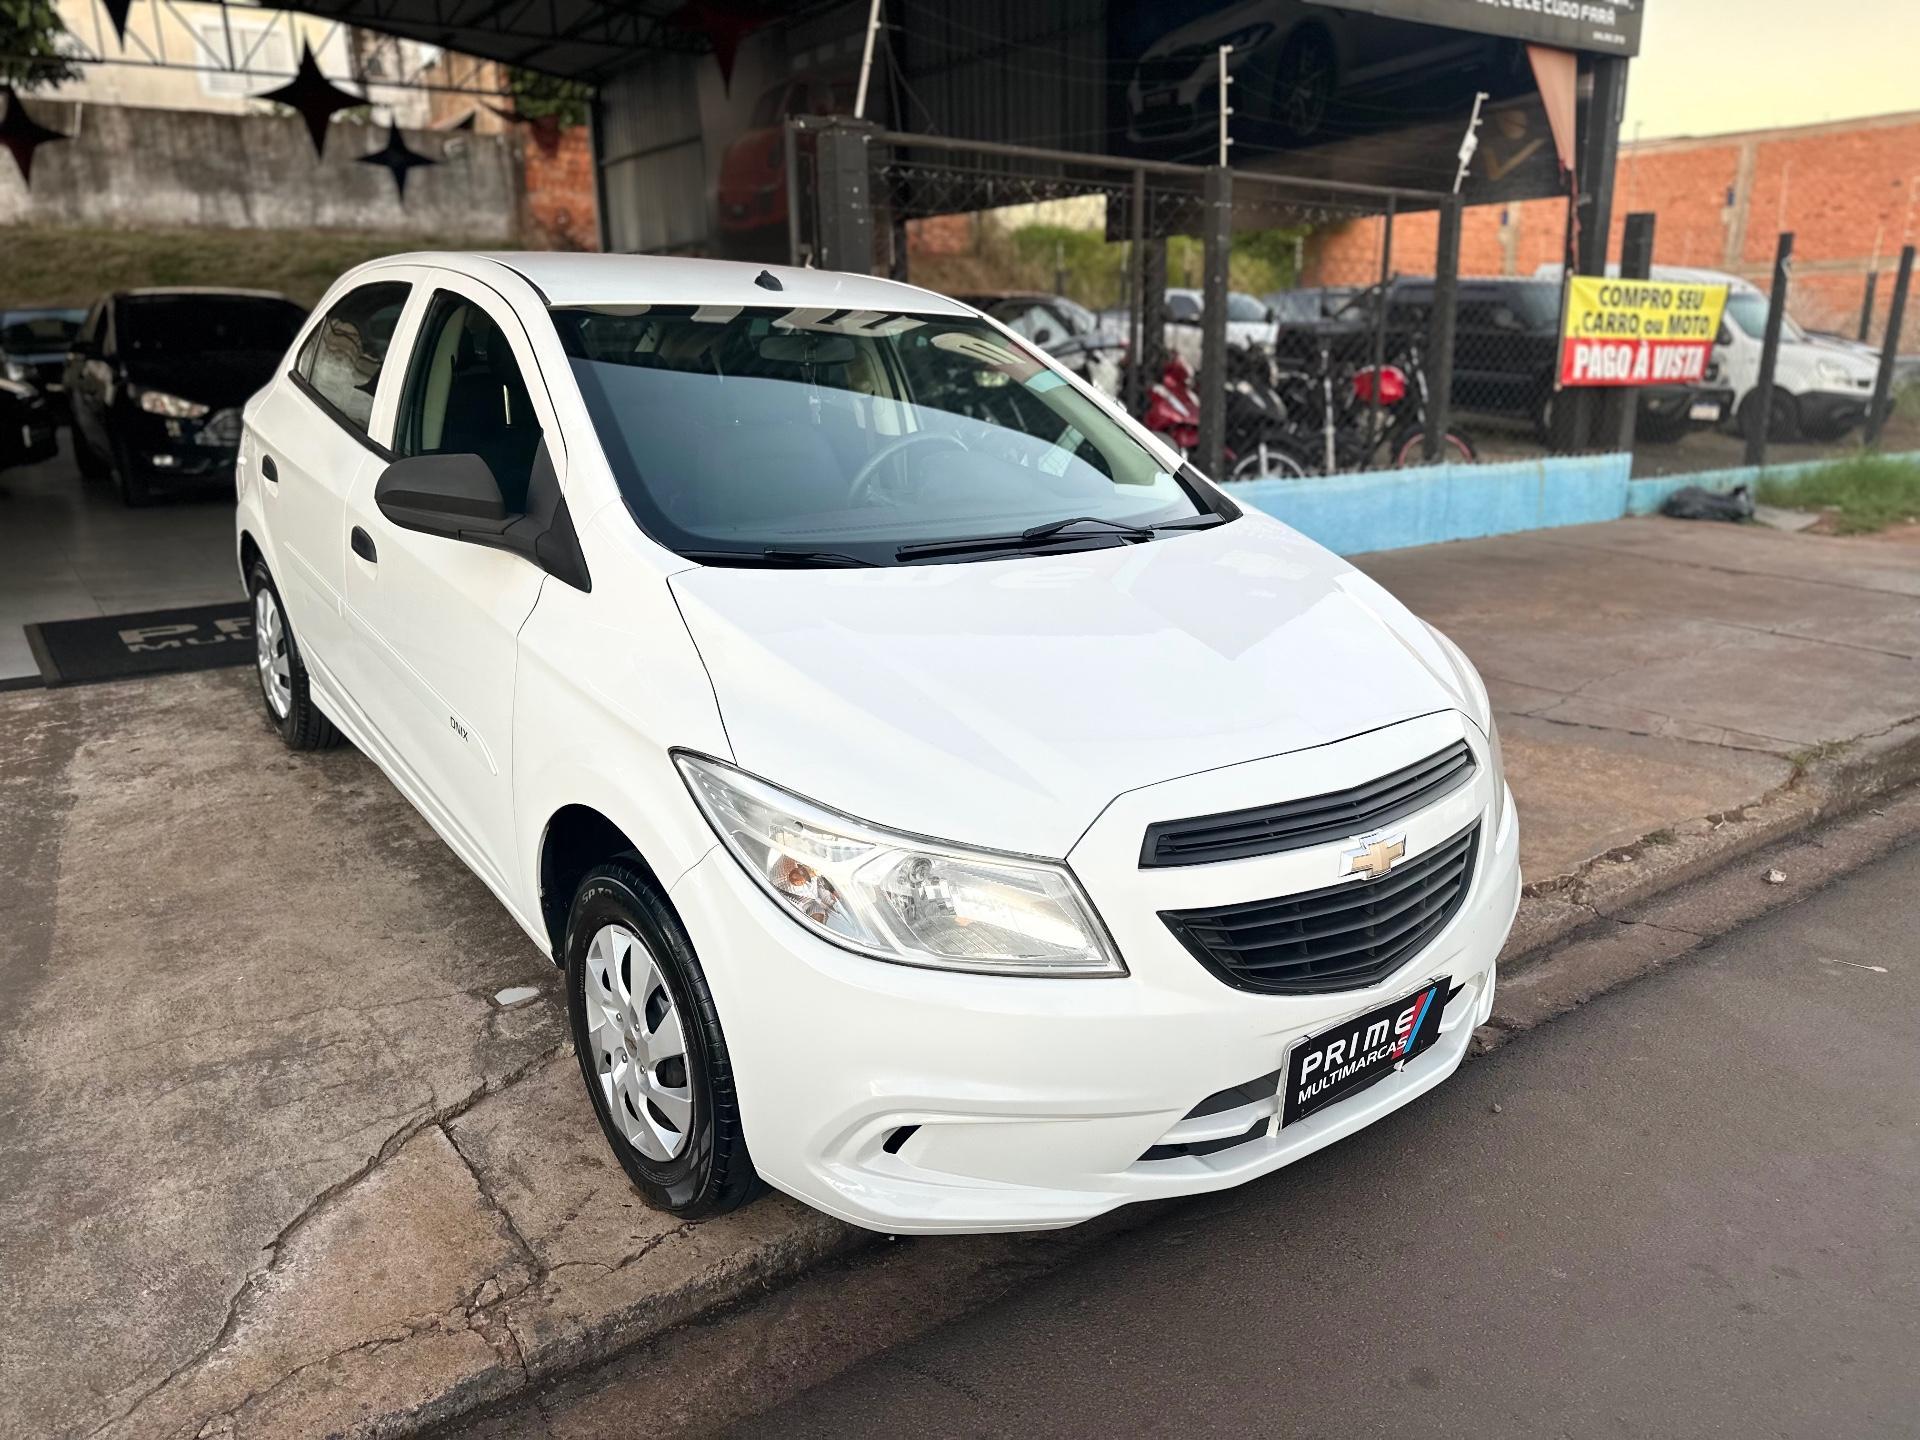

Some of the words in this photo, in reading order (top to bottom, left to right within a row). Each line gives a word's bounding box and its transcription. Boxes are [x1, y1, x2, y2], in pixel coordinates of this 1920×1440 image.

[1599, 285, 1674, 309] COMPRO
[1676, 289, 1705, 311] SEU
[1582, 311, 1640, 334] CARRO
[1644, 319, 1664, 334] ou
[1668, 315, 1710, 337] MOTO
[1572, 343, 1633, 380] PAGO
[1632, 339, 1650, 380] À
[1651, 345, 1706, 380] VISTA
[450, 716, 468, 742] ONIX
[1300, 1005, 1417, 1085] PRIME
[1297, 1036, 1408, 1104] MULTIMARCAS
